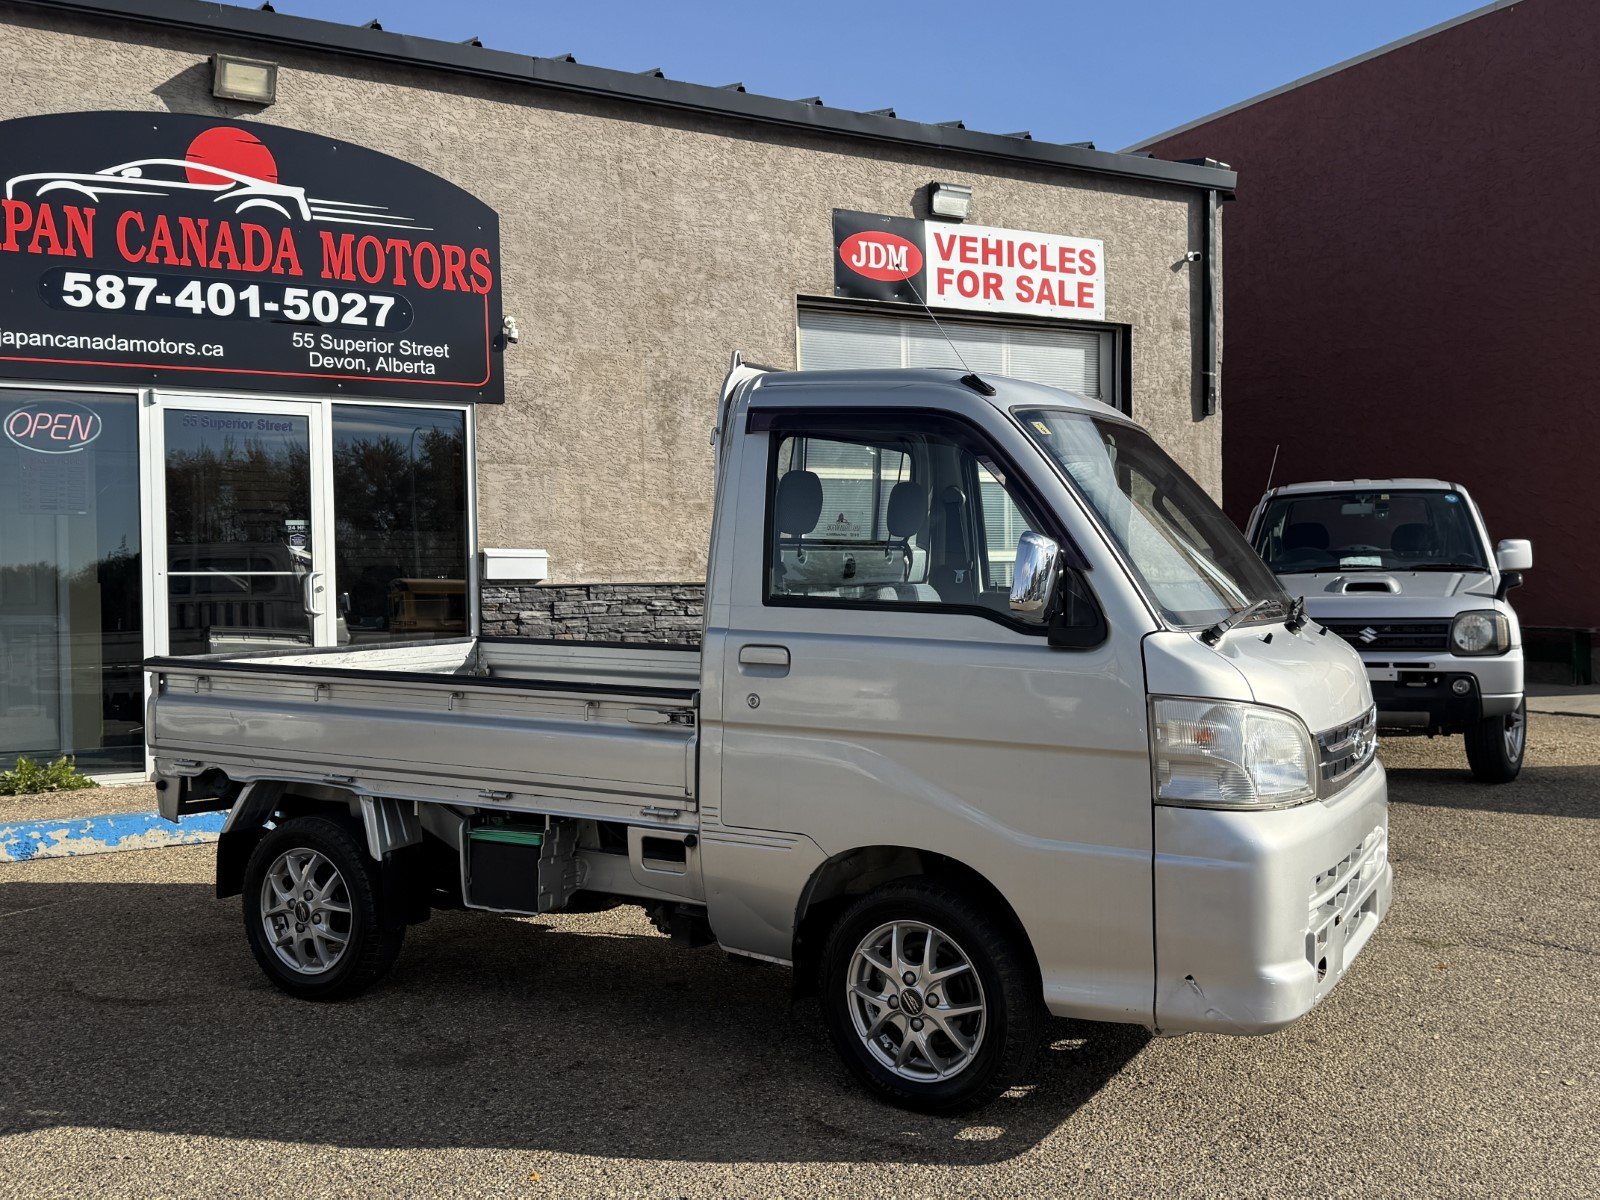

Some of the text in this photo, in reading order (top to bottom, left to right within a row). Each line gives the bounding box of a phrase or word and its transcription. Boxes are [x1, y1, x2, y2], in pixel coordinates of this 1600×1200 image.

[0, 199, 494, 295] PAN CANADA MOTORS
[851, 240, 909, 272] JDM
[933, 232, 1097, 276] VEHICLES
[62, 271, 395, 327] 587-401-5027
[936, 267, 1095, 309] FOR SALE
[292, 332, 450, 358] 55 Superior Street
[309, 351, 436, 375] Devon, Alberta
[9, 411, 93, 441] OPEN
[182, 413, 294, 432] 55 Superior Street
